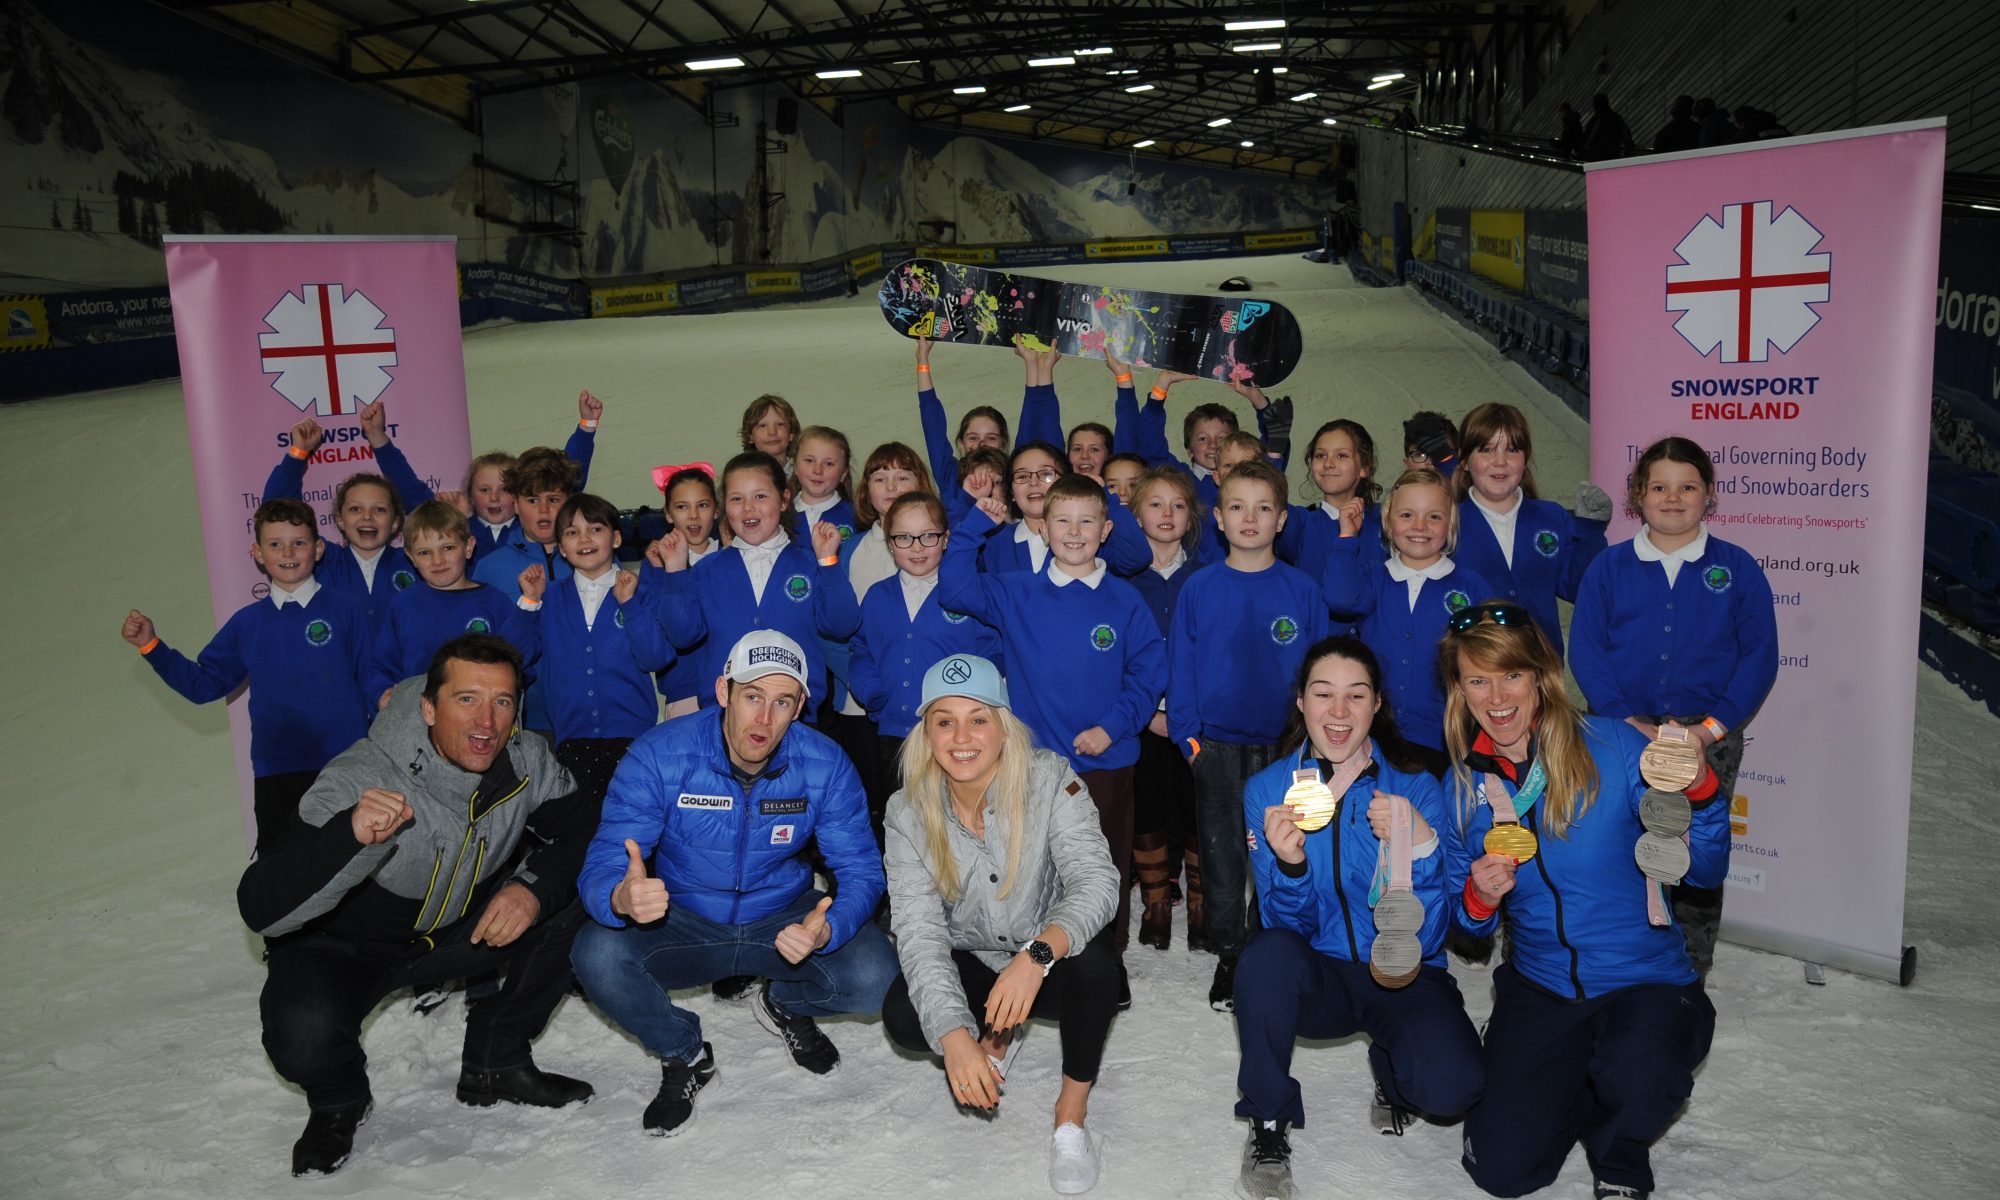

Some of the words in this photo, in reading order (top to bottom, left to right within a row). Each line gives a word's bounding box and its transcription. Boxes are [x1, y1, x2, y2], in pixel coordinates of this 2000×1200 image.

[62, 299, 118, 317] Andorra,
[122, 299, 148, 315] your
[1057, 317, 1091, 334] VIVO
[1671, 376, 1820, 397] SNOWSPORT
[1691, 402, 1800, 420] ENGLAND
[309, 444, 374, 465] NGLAN
[1730, 446, 1816, 471] Governing
[1821, 446, 1867, 472] Body
[1716, 476, 1736, 494] nd
[1741, 475, 1869, 498] Snowboarders
[242, 493, 261, 509] Th
[1728, 514, 1745, 524] and
[1747, 513, 1803, 529] Celebrating
[680, 796, 731, 808] GOLDWIN
